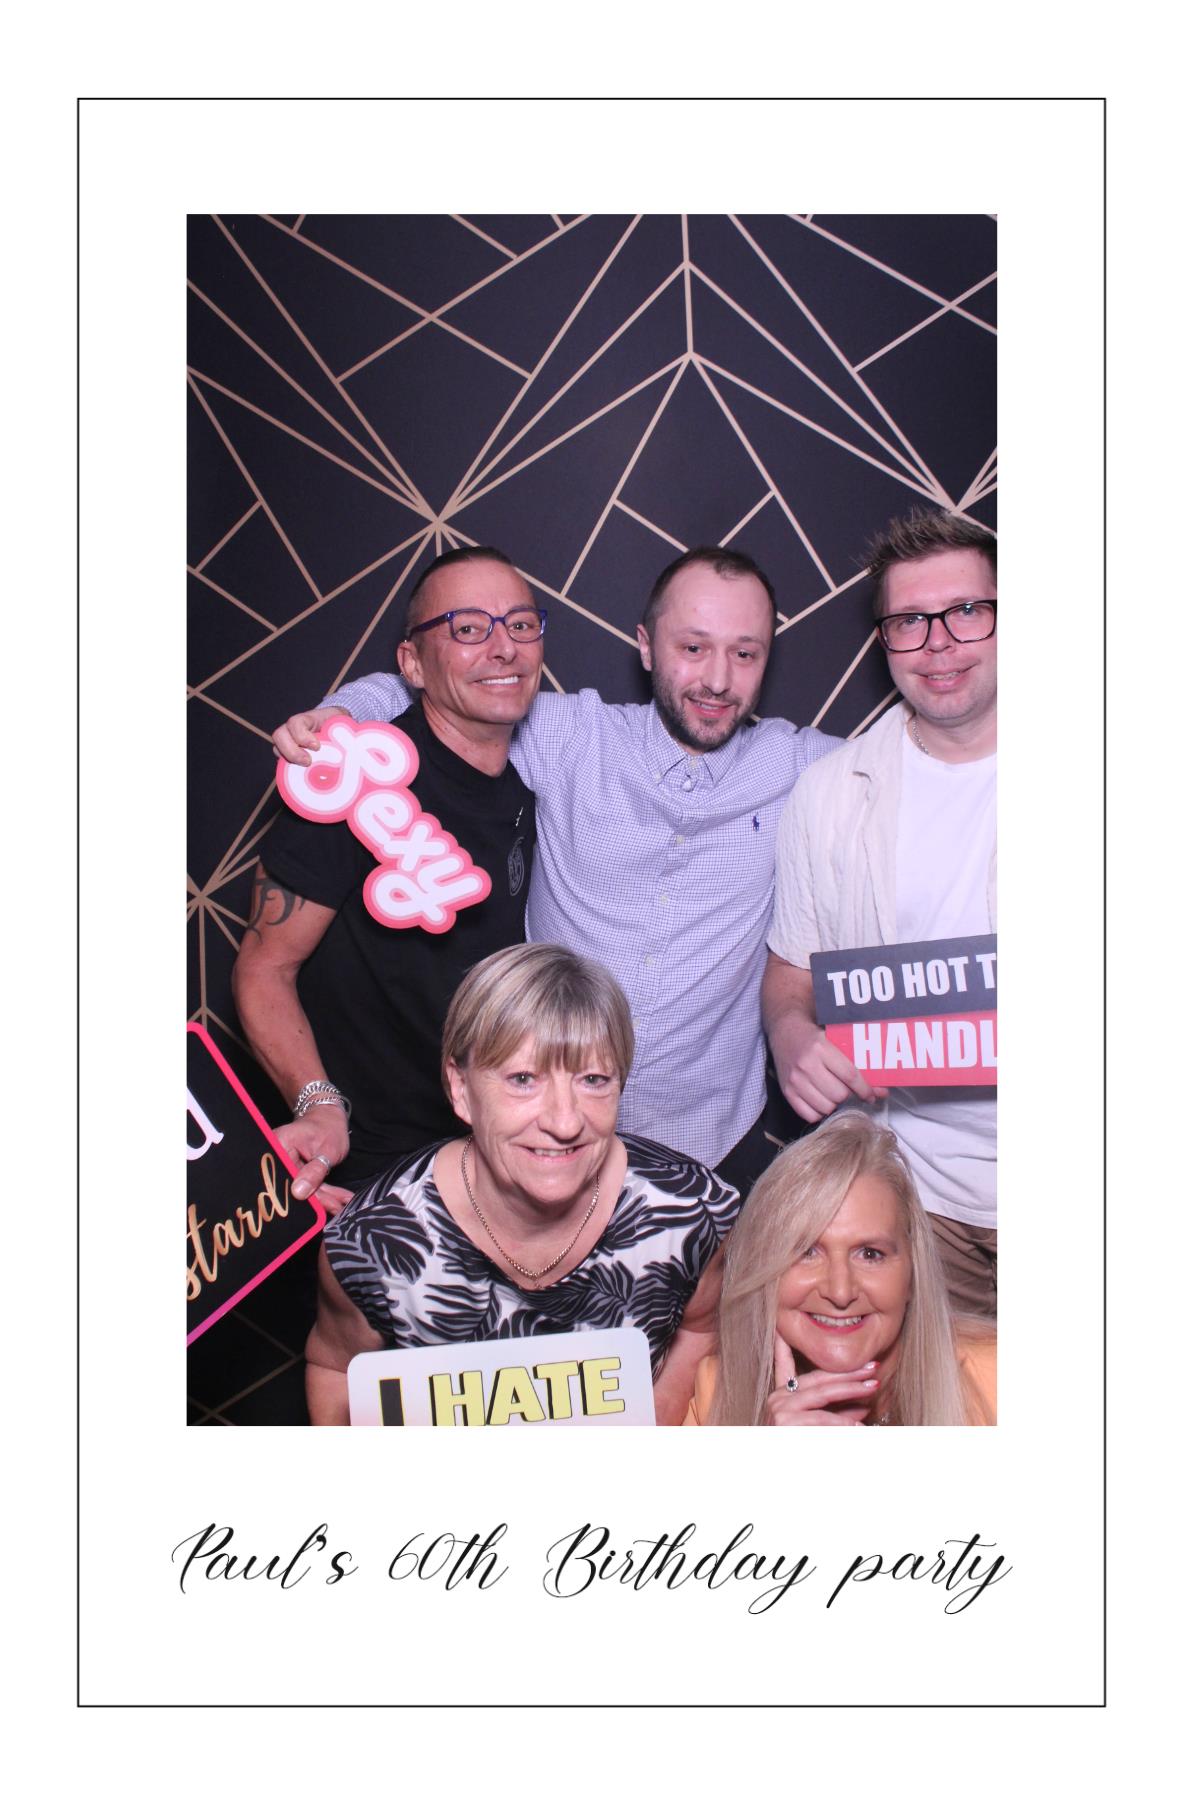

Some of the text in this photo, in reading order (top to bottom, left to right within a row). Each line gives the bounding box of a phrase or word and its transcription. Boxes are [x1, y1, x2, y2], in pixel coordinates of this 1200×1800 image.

[285, 724, 485, 925] Sexy
[827, 965, 896, 1007] TOO
[901, 956, 969, 999] HOT
[852, 1019, 997, 1070] HANDL
[378, 1356, 626, 1426] I HATE
